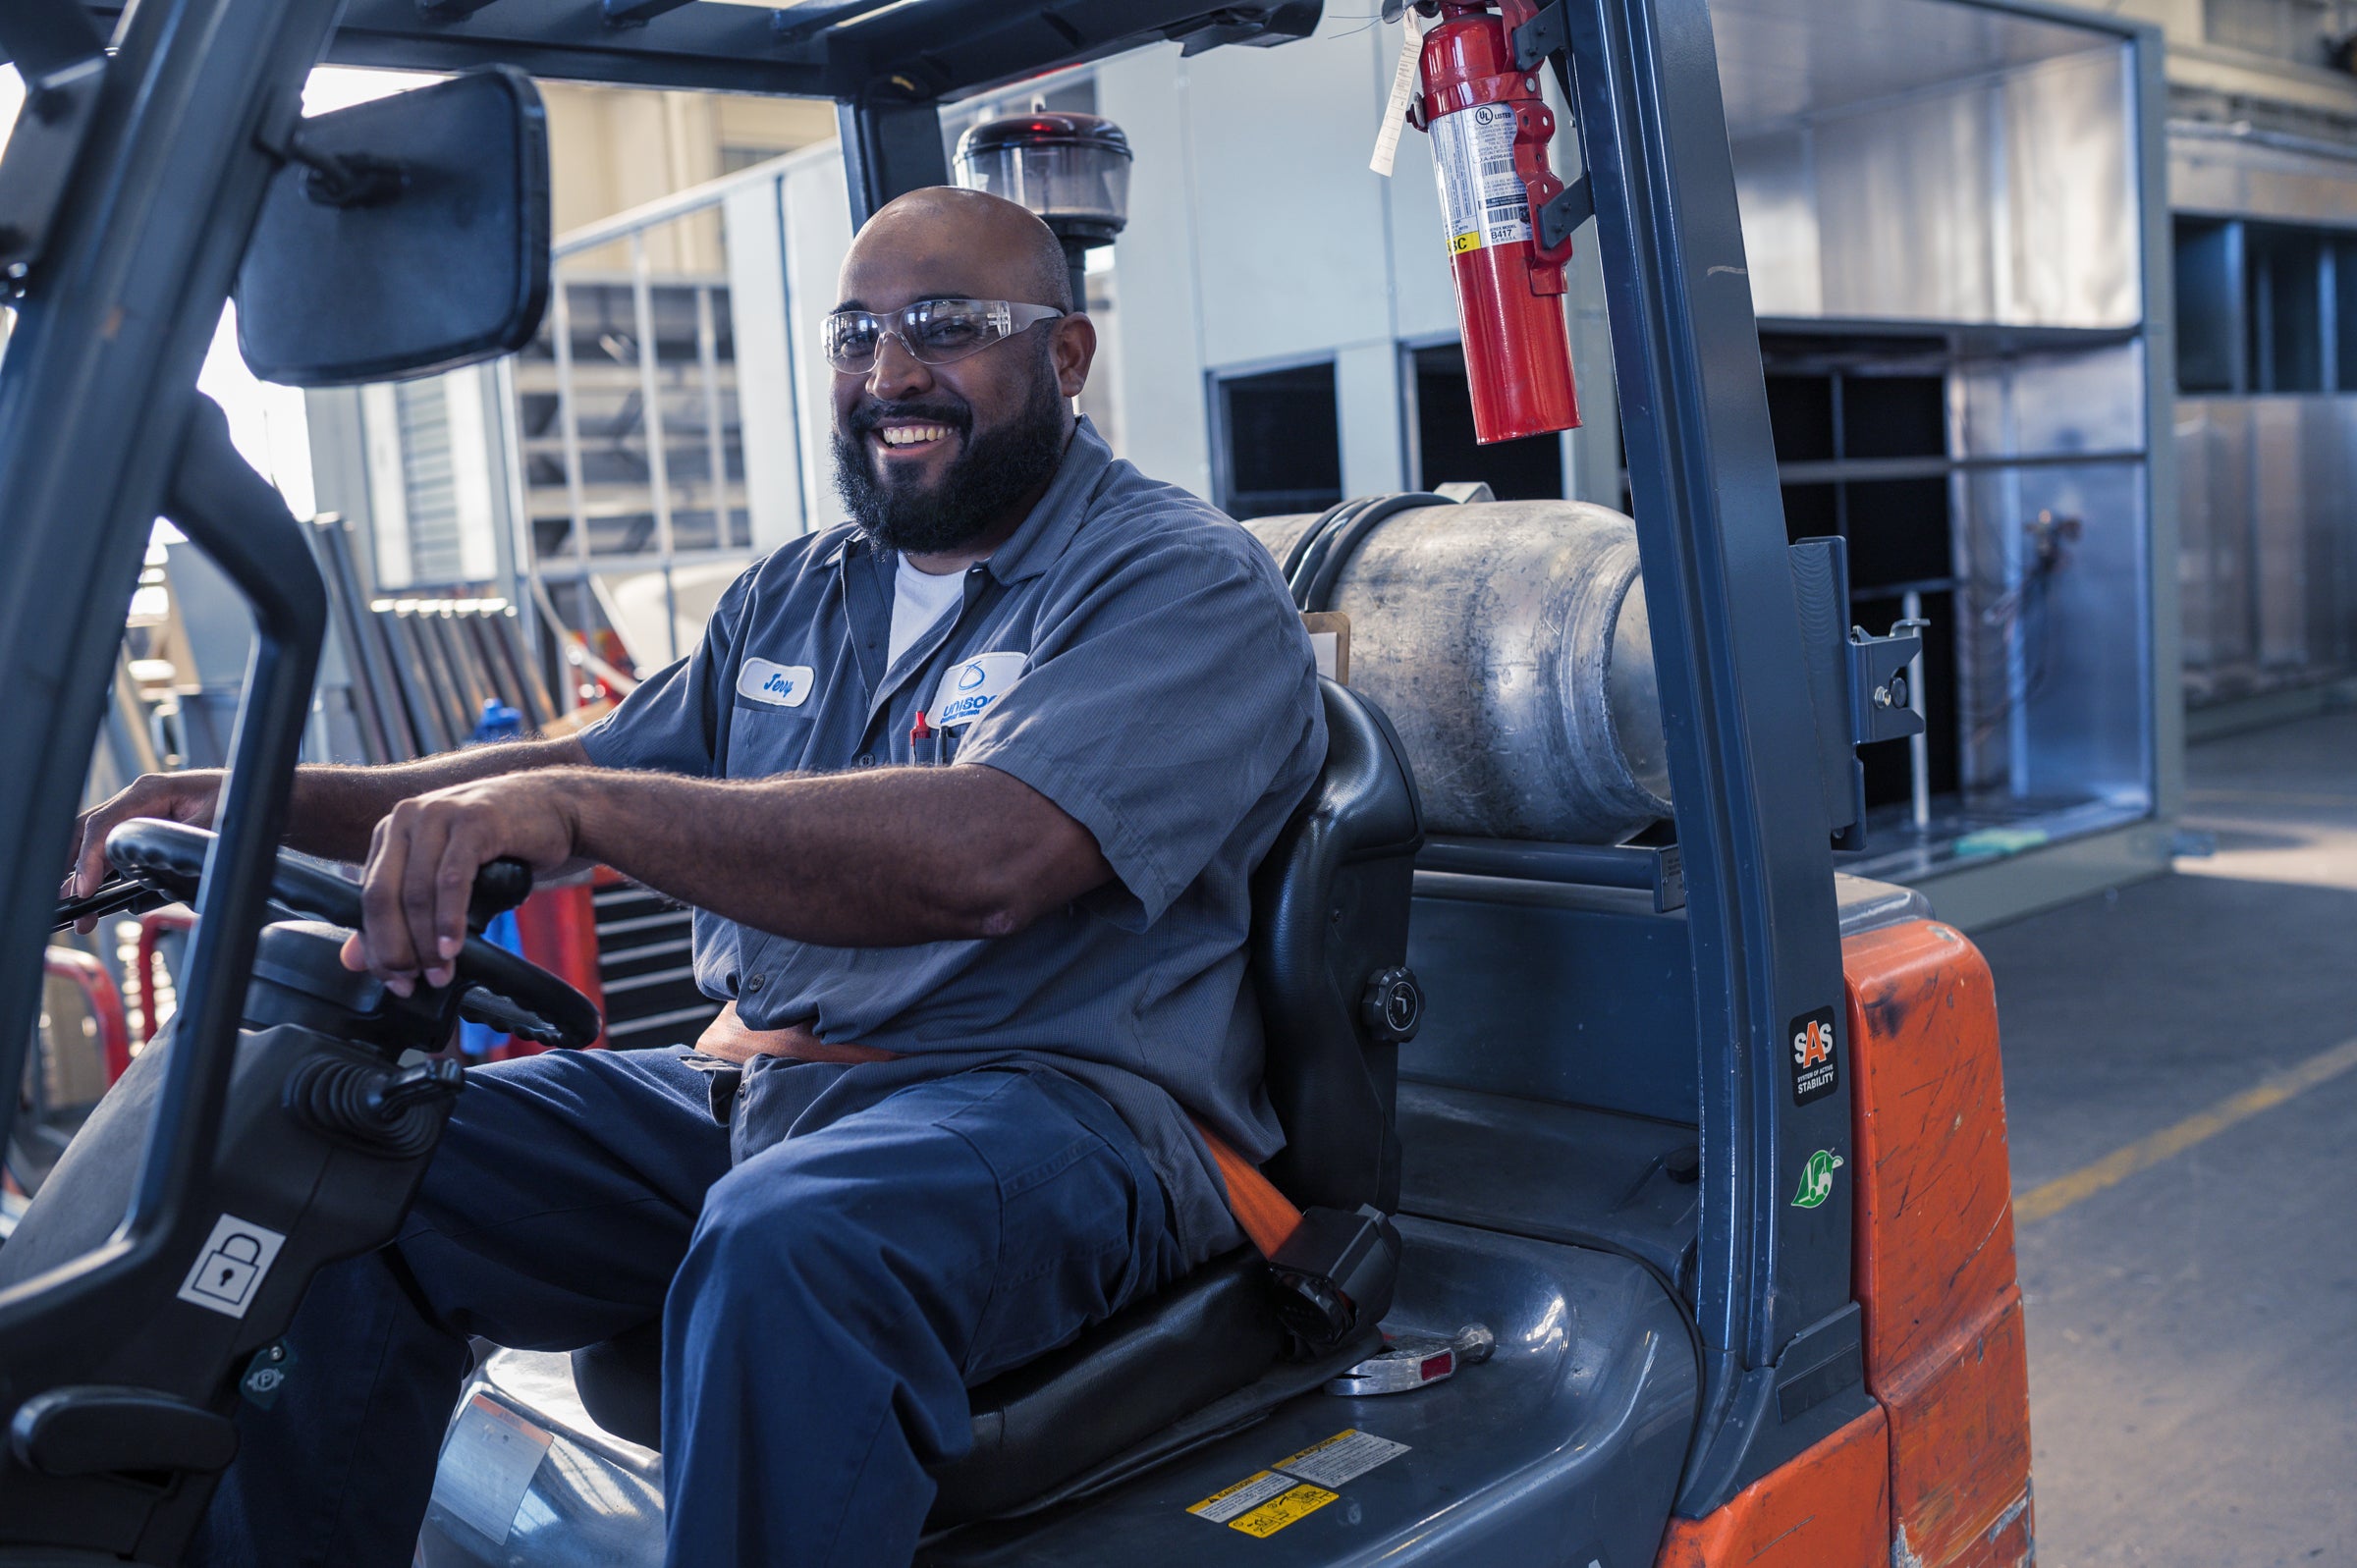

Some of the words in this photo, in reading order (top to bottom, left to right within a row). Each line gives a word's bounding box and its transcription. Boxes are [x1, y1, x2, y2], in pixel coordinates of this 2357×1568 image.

[1448, 237, 1467, 252] BC
[1491, 229, 1512, 240] B417
[763, 673, 794, 698] Jerry
[1794, 1020, 1834, 1069] SAS
[1797, 1071, 1813, 1083] SYSTEM
[1819, 1063, 1834, 1074] ACTIVE
[1797, 1071, 1835, 1095] STABILITY
[1218, 1479, 1253, 1498] CAUTION
